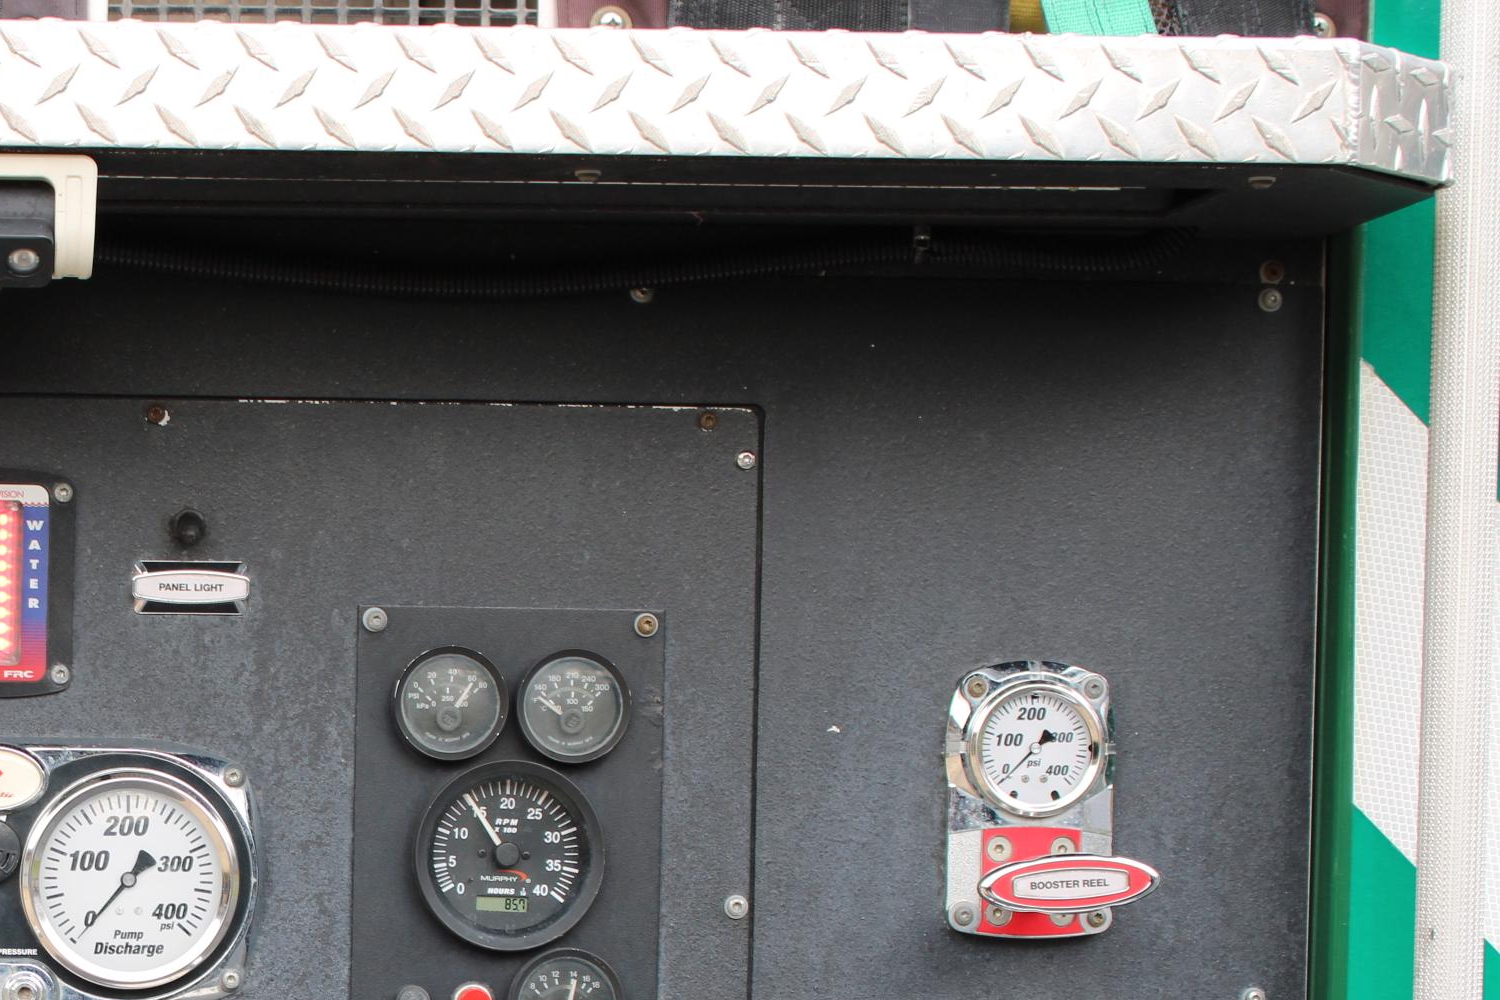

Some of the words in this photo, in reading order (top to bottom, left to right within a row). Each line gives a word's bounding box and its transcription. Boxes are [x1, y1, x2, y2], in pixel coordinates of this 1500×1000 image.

[158, 583, 191, 592] PANEL
[194, 583, 224, 592] LIGHT
[3, 670, 35, 679] FRC
[1017, 707, 1046, 721] 200
[995, 733, 1024, 746] 100
[1002, 764, 1010, 774] 0
[1027, 758, 1041, 768] psi
[1046, 765, 1068, 776] 400
[500, 798, 516, 810] 20
[527, 808, 542, 820] 25
[103, 816, 149, 836] 200
[495, 818, 519, 826] RPM
[454, 828, 468, 840] 10
[544, 832, 560, 844] 30
[69, 850, 110, 872] 100
[157, 856, 194, 872] 300
[448, 856, 456, 868] 5
[546, 860, 562, 872] 35
[457, 883, 465, 895] 0
[532, 884, 548, 896] 40
[1030, 880, 1080, 890] BOOSTER
[1082, 878, 1109, 888] REEL
[152, 903, 188, 920] 400
[84, 911, 96, 927] 0
[160, 922, 174, 932] psi
[114, 930, 144, 941] Pump
[94, 942, 164, 958] Discharge
